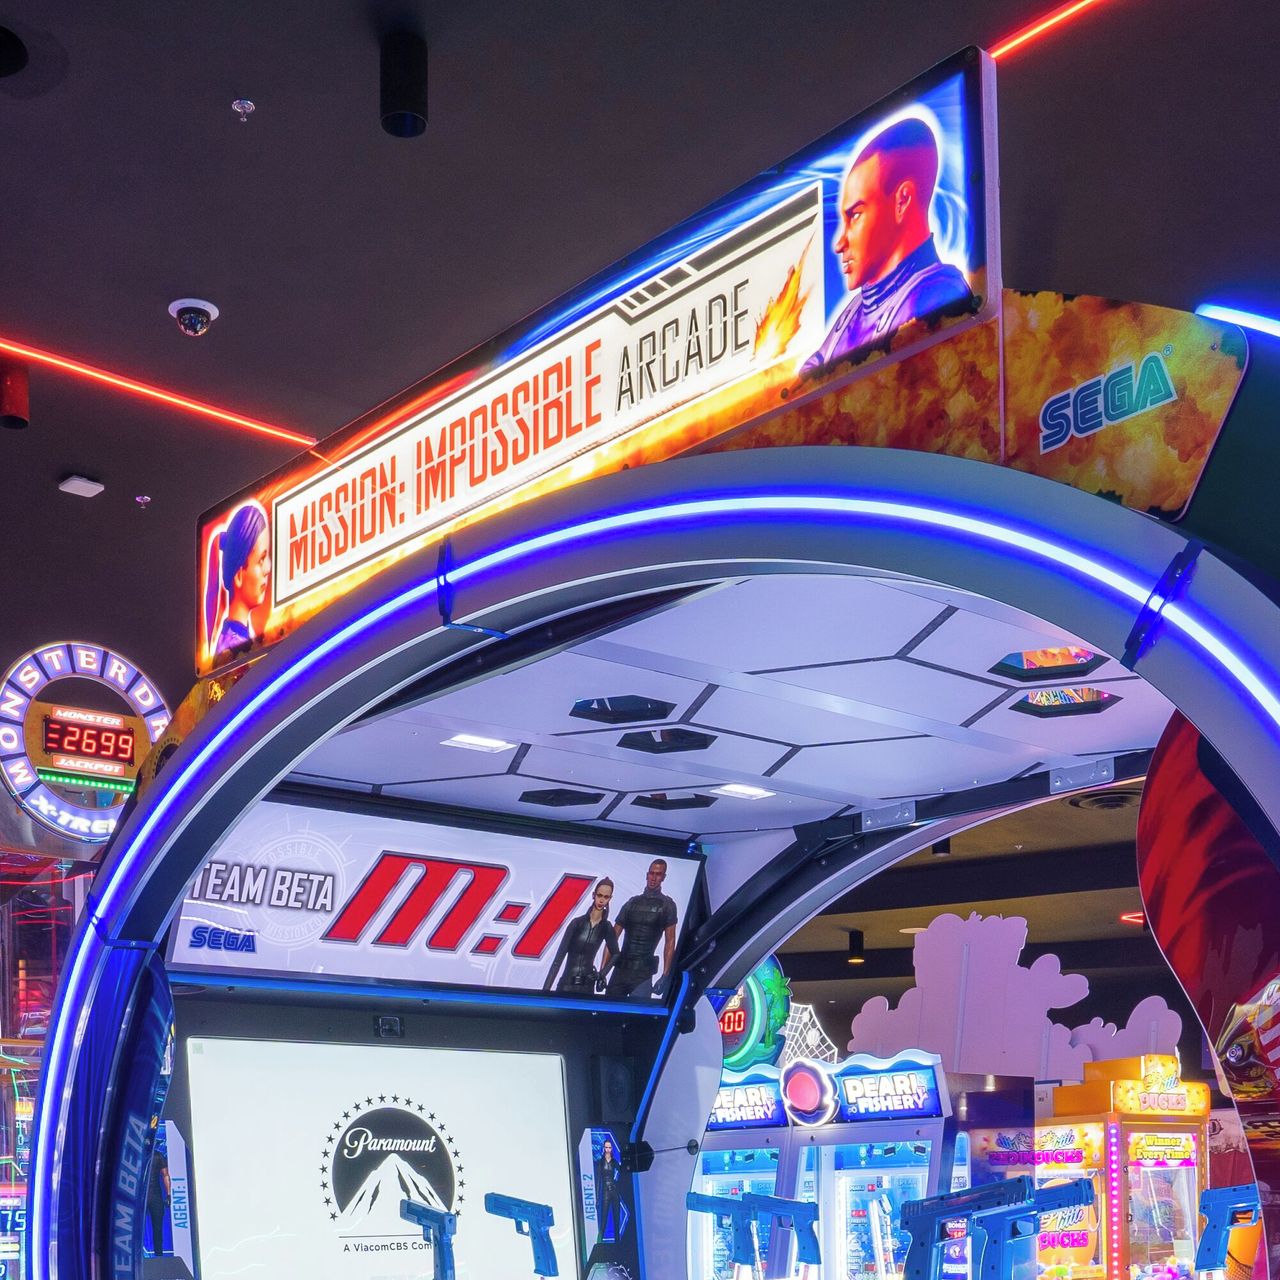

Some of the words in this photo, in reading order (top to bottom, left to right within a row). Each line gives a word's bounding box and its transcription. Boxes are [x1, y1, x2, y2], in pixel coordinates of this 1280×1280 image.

[1039, 351, 1178, 455] SEGA
[288, 455, 405, 581] MISSION:
[415, 338, 602, 516] IMPOSSIBLE
[616, 278, 750, 412] ARCADE
[55, 709, 121, 726] MONSTER
[55, 757, 122, 774] JACKPOT
[192, 862, 267, 904] TEAM
[270, 870, 334, 911] BETA
[189, 925, 257, 953] SEGA
[842, 1072, 926, 1105] PEARL
[858, 1088, 929, 1114] FISHERY
[1138, 1092, 1187, 1111] DUCKS
[716, 1098, 777, 1124] FISHERY
[343, 1127, 437, 1159] Paramount
[1144, 1134, 1182, 1147] Winner
[117, 1113, 148, 1197] BETA
[1136, 1148, 1164, 1161] Every
[1164, 1148, 1191, 1160] Time
[172, 1183, 189, 1230] AGENT:
[583, 1184, 597, 1221] AGENT:
[343, 1243, 351, 1252] A
[353, 1241, 409, 1252] ViacomCBS
[1038, 1229, 1089, 1250] DUCKS
